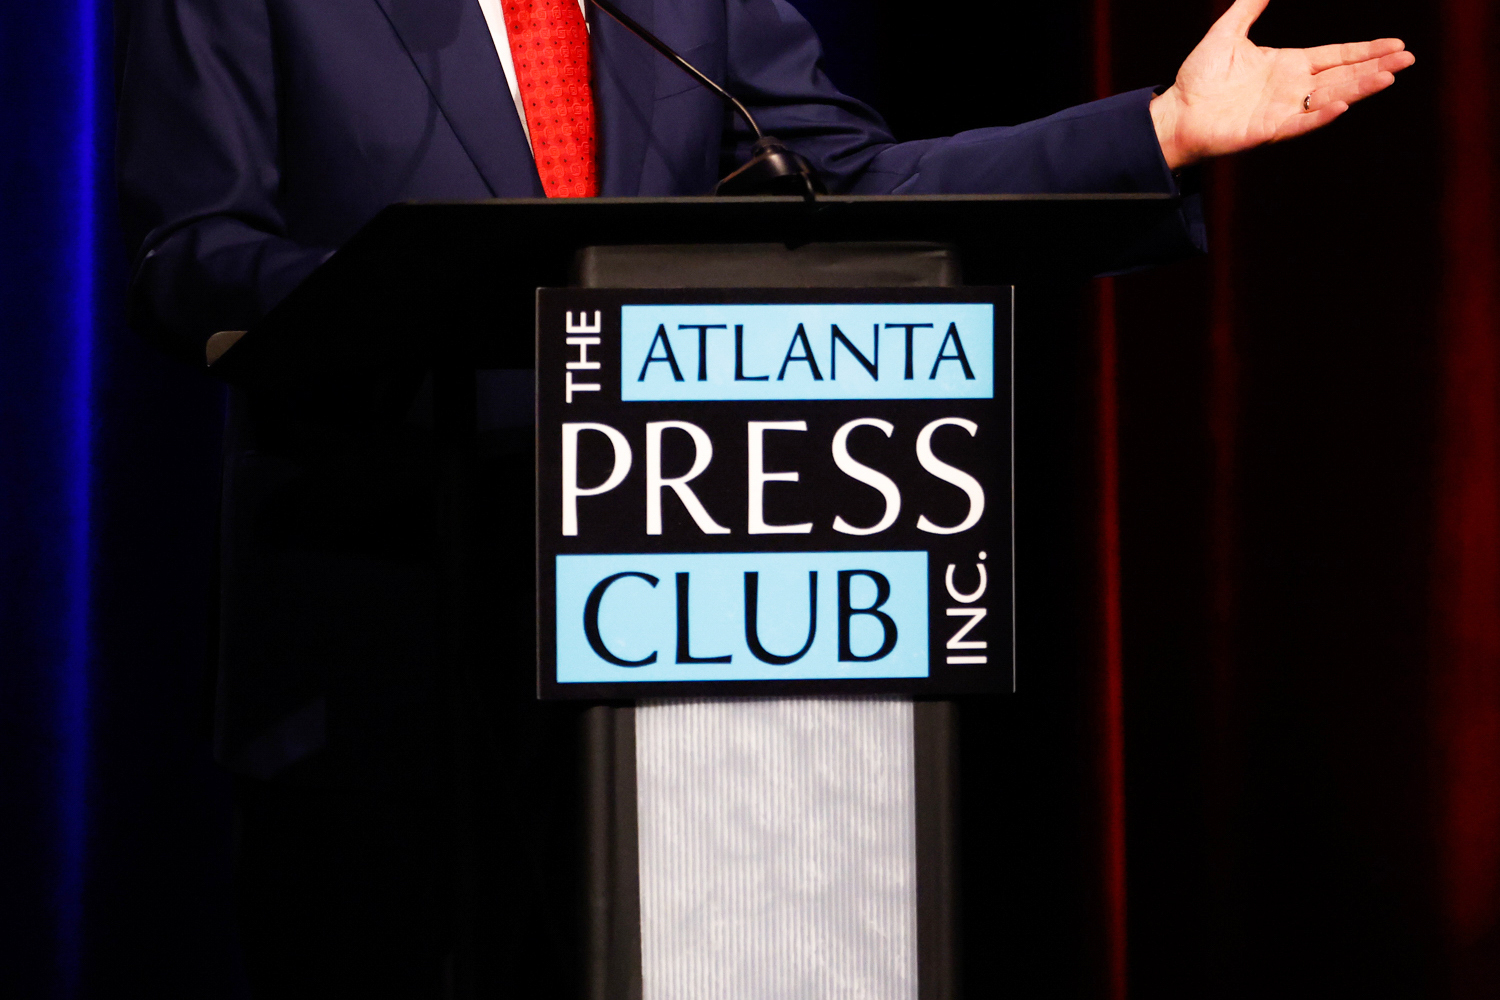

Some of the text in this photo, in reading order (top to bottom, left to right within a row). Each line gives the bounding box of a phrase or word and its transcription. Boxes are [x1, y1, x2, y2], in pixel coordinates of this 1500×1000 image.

[565, 310, 601, 404] THE
[637, 321, 976, 382] ATLANTA
[561, 417, 985, 536] PRESS
[582, 568, 899, 668] CLUB
[945, 551, 988, 665] INC.
